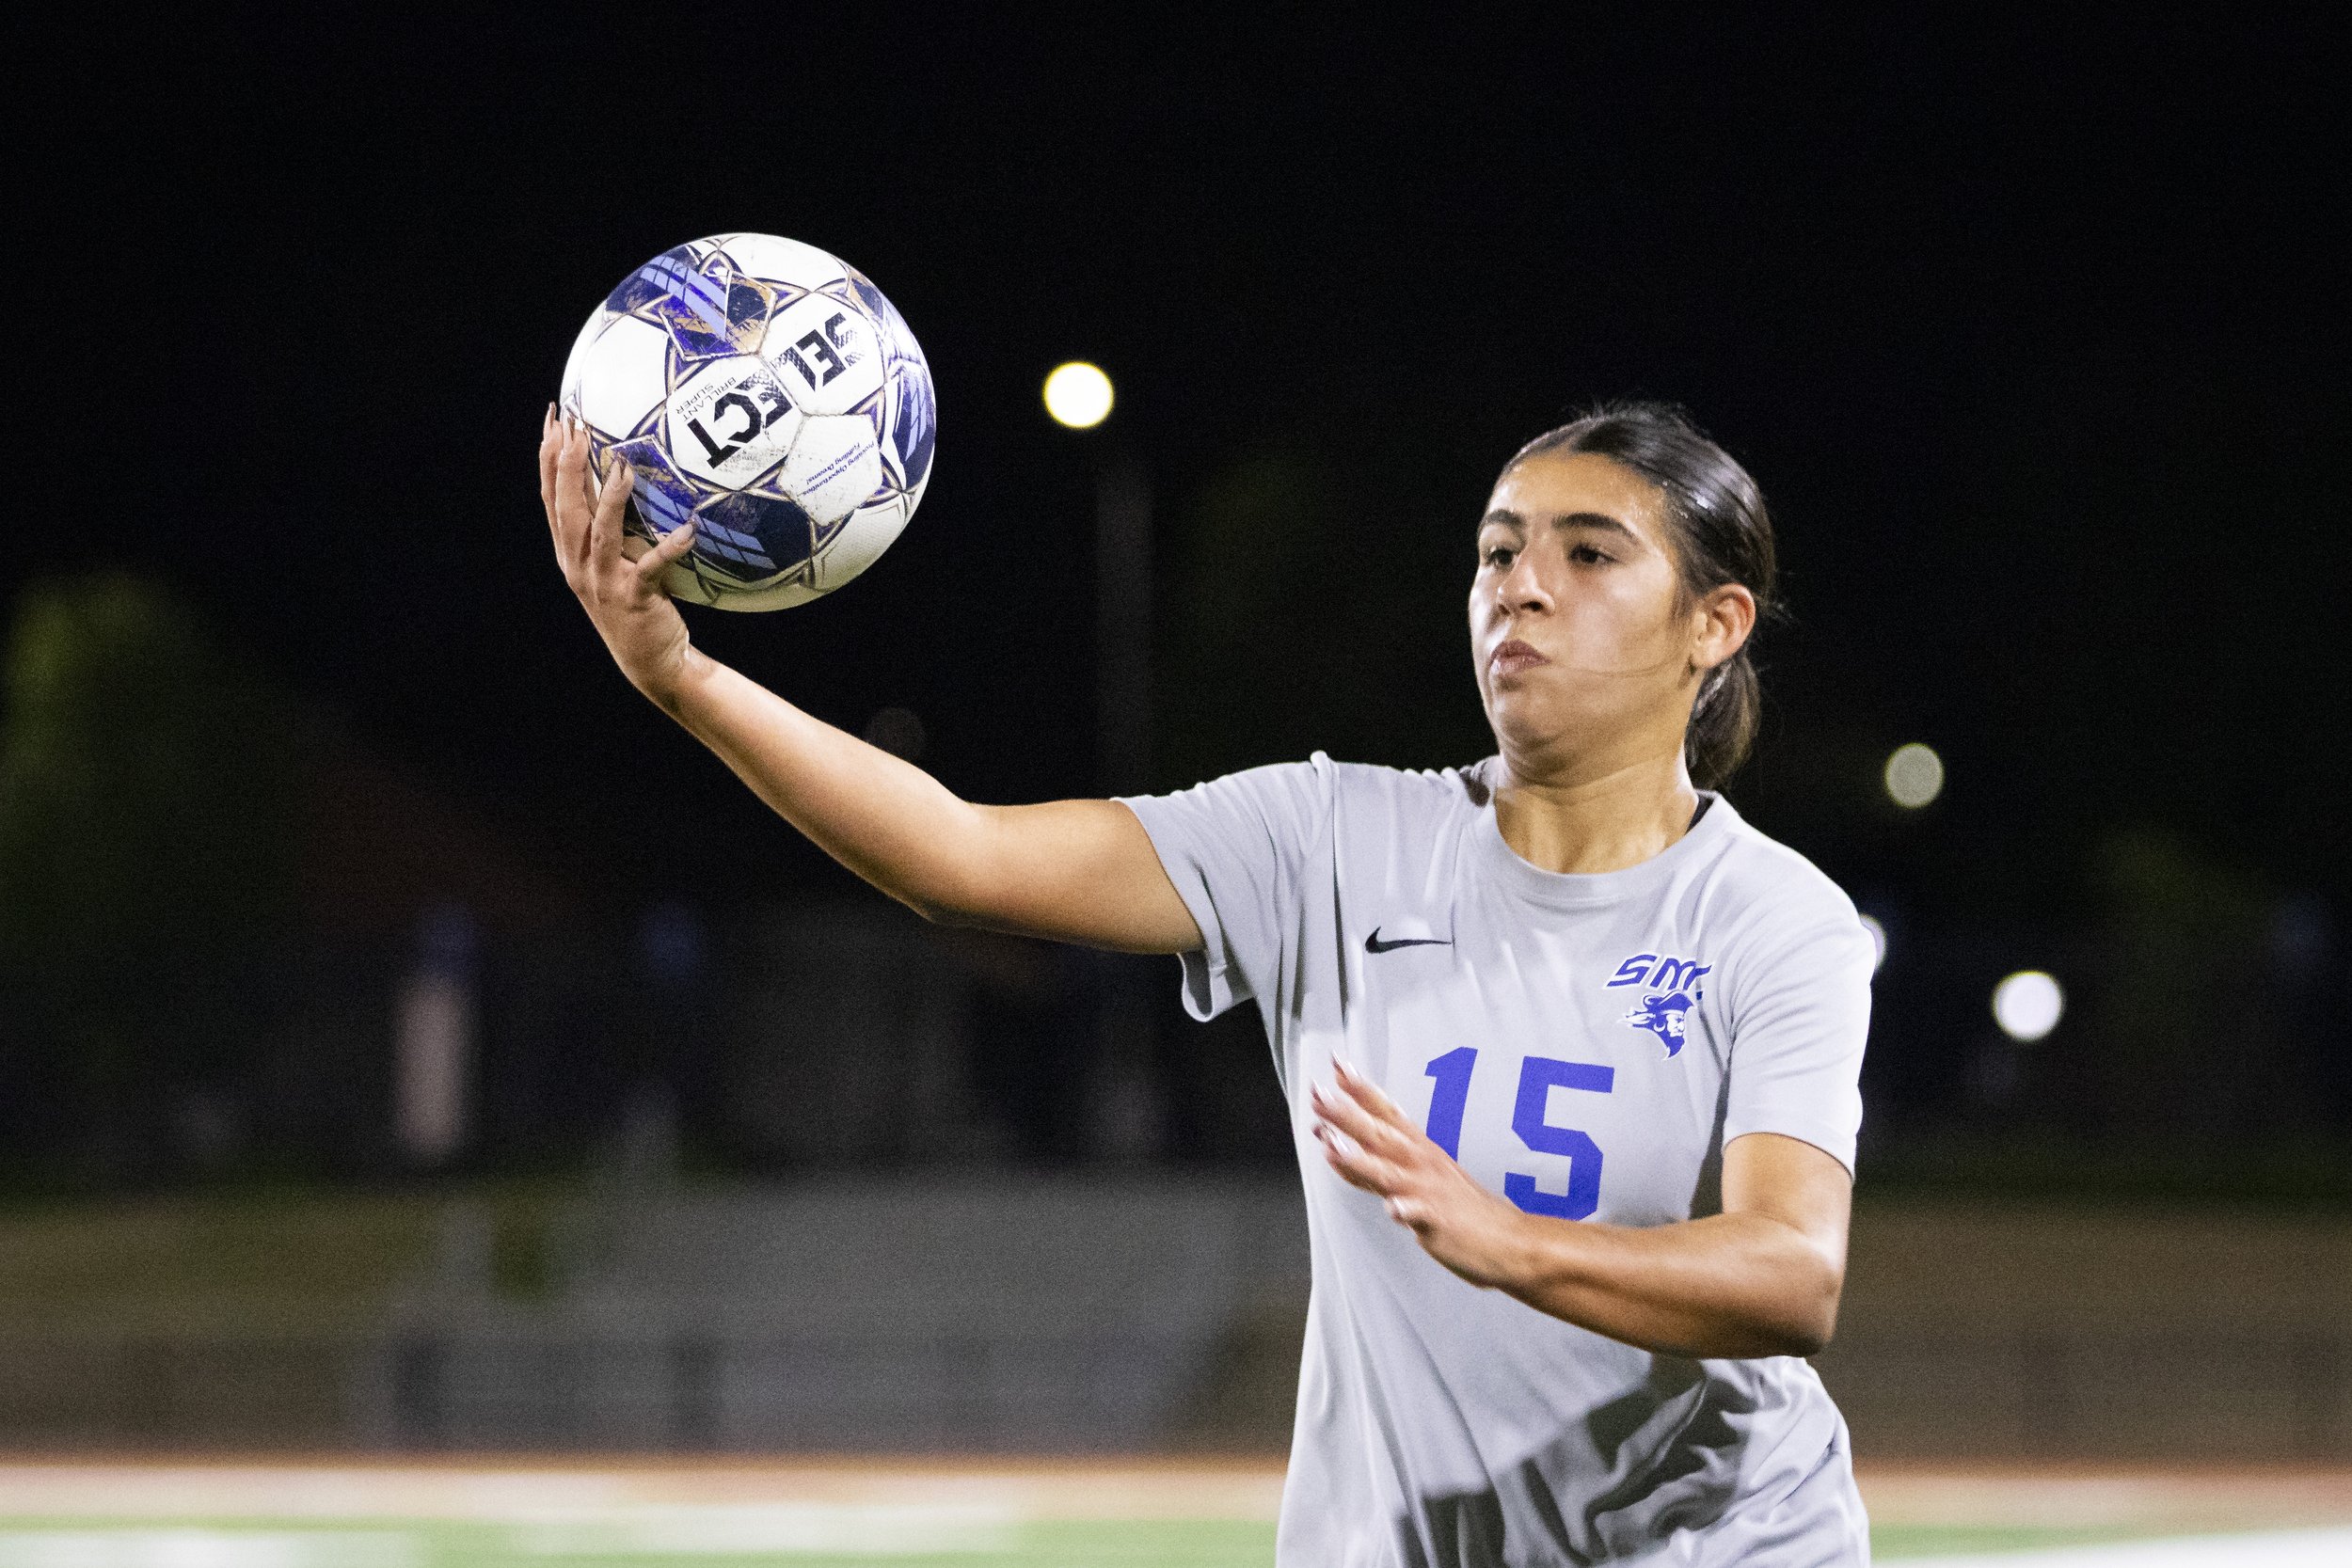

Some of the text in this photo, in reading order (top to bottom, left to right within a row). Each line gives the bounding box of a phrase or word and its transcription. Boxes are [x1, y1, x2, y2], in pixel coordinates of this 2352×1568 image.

[675, 383, 714, 414] SUPER
[683, 377, 736, 421] BRILLANT
[849, 440, 875, 467] Providing
[806, 464, 834, 485] Dreams!
[1424, 1046, 1615, 1222] 15
